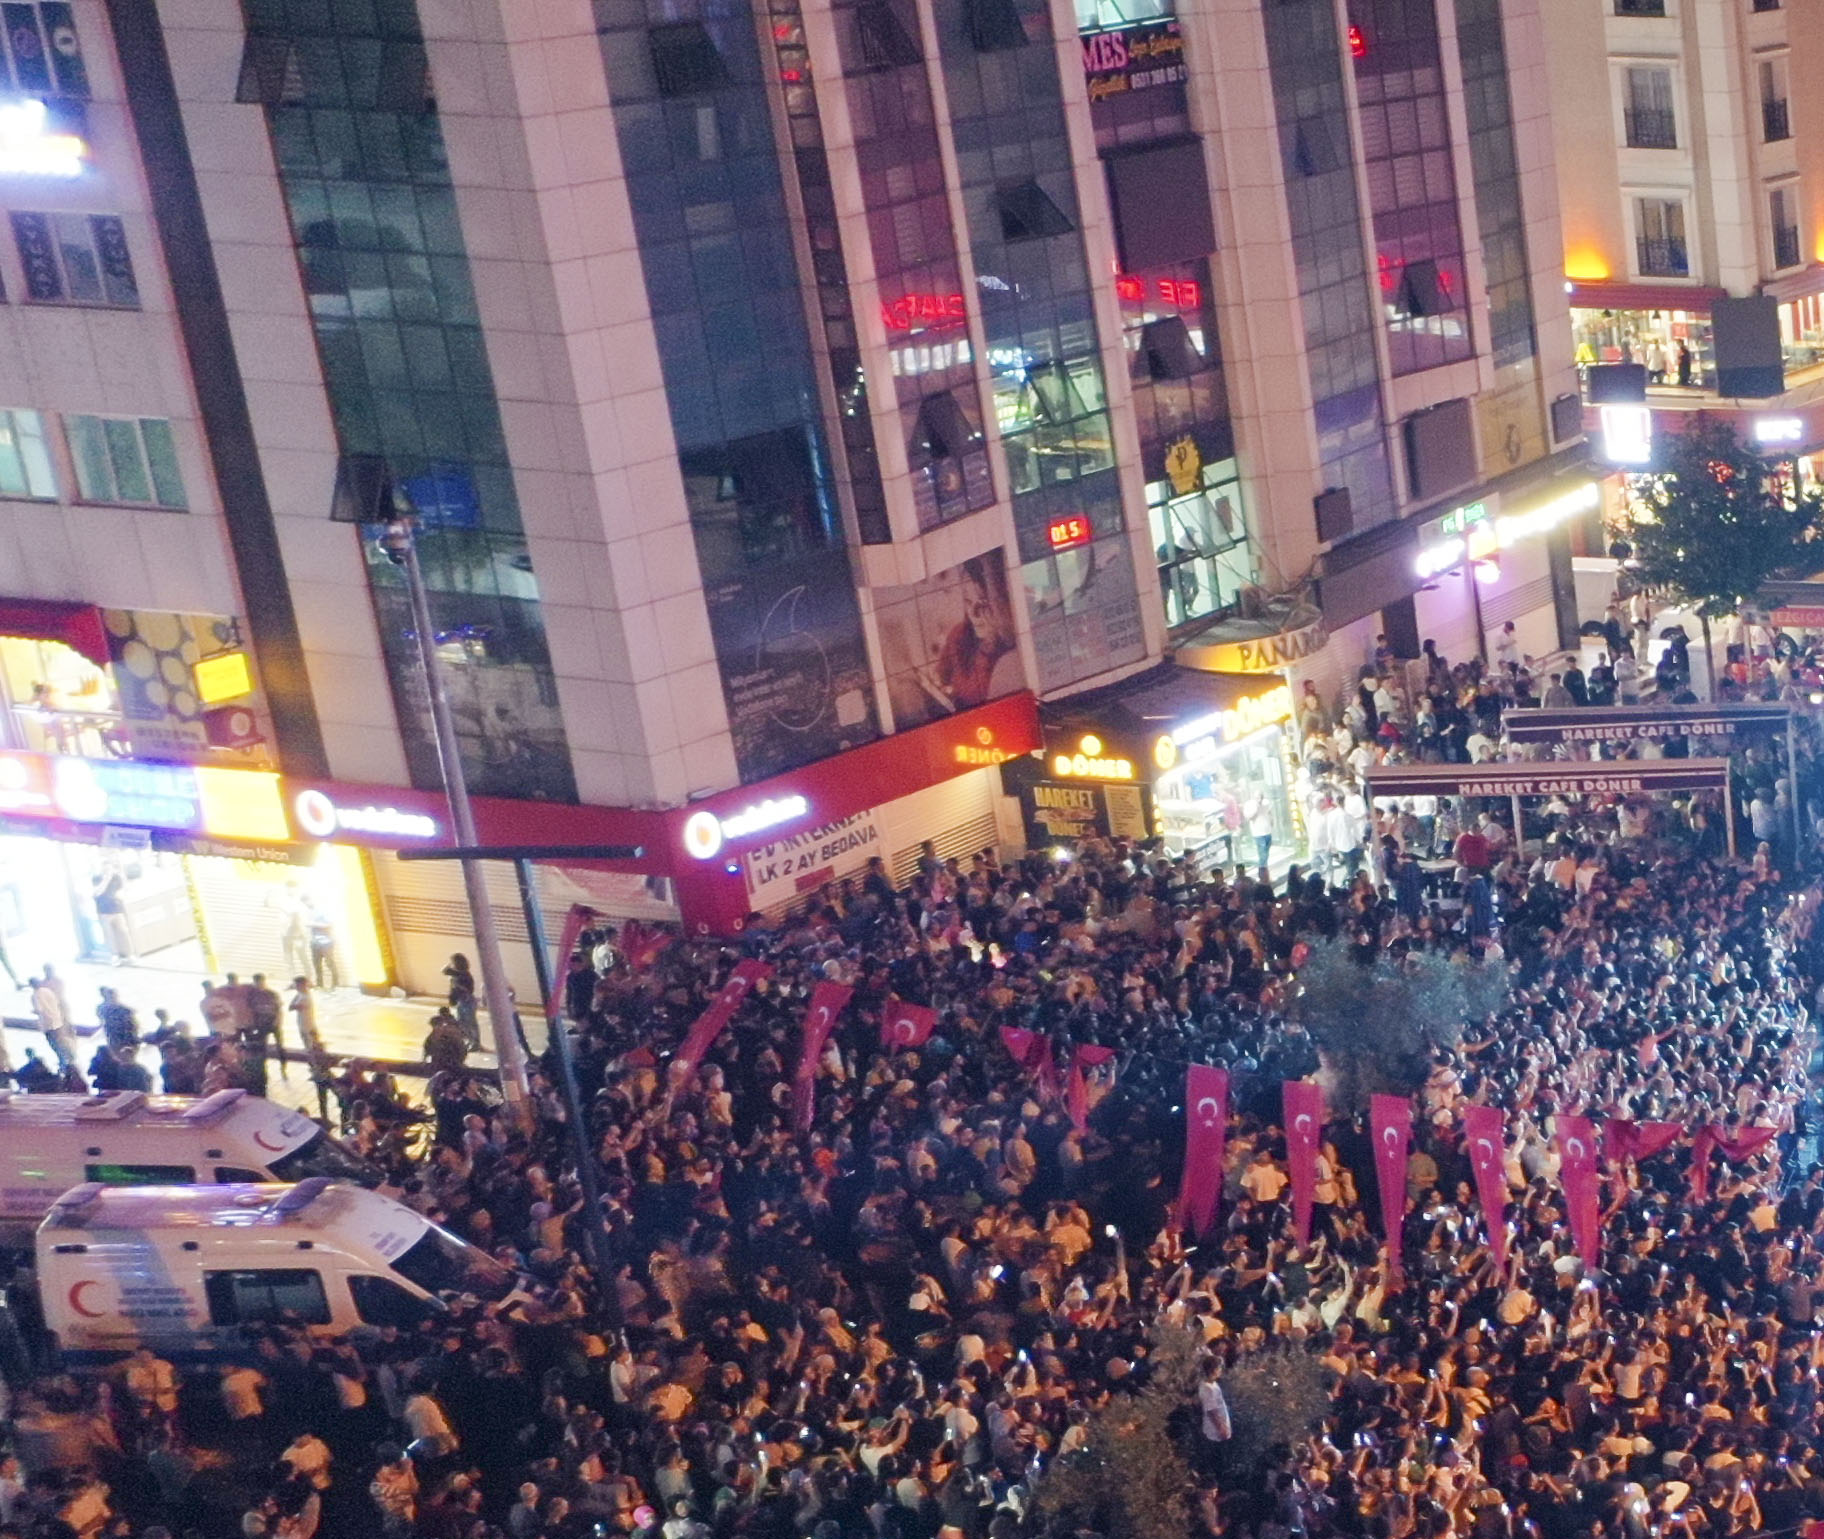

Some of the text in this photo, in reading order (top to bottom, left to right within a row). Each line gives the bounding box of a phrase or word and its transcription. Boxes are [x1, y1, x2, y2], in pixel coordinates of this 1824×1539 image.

[1562, 721, 1735, 741] HAREKET CAFE DÖNER
[1458, 779, 1642, 795] HAREKET CAFE DÖNER
[1033, 786, 1093, 810] HAREKET
[257, 846, 290, 861] Union
[783, 860, 793, 875] 2
[797, 853, 817, 871] AY
[821, 824, 879, 862] BEDAVA
